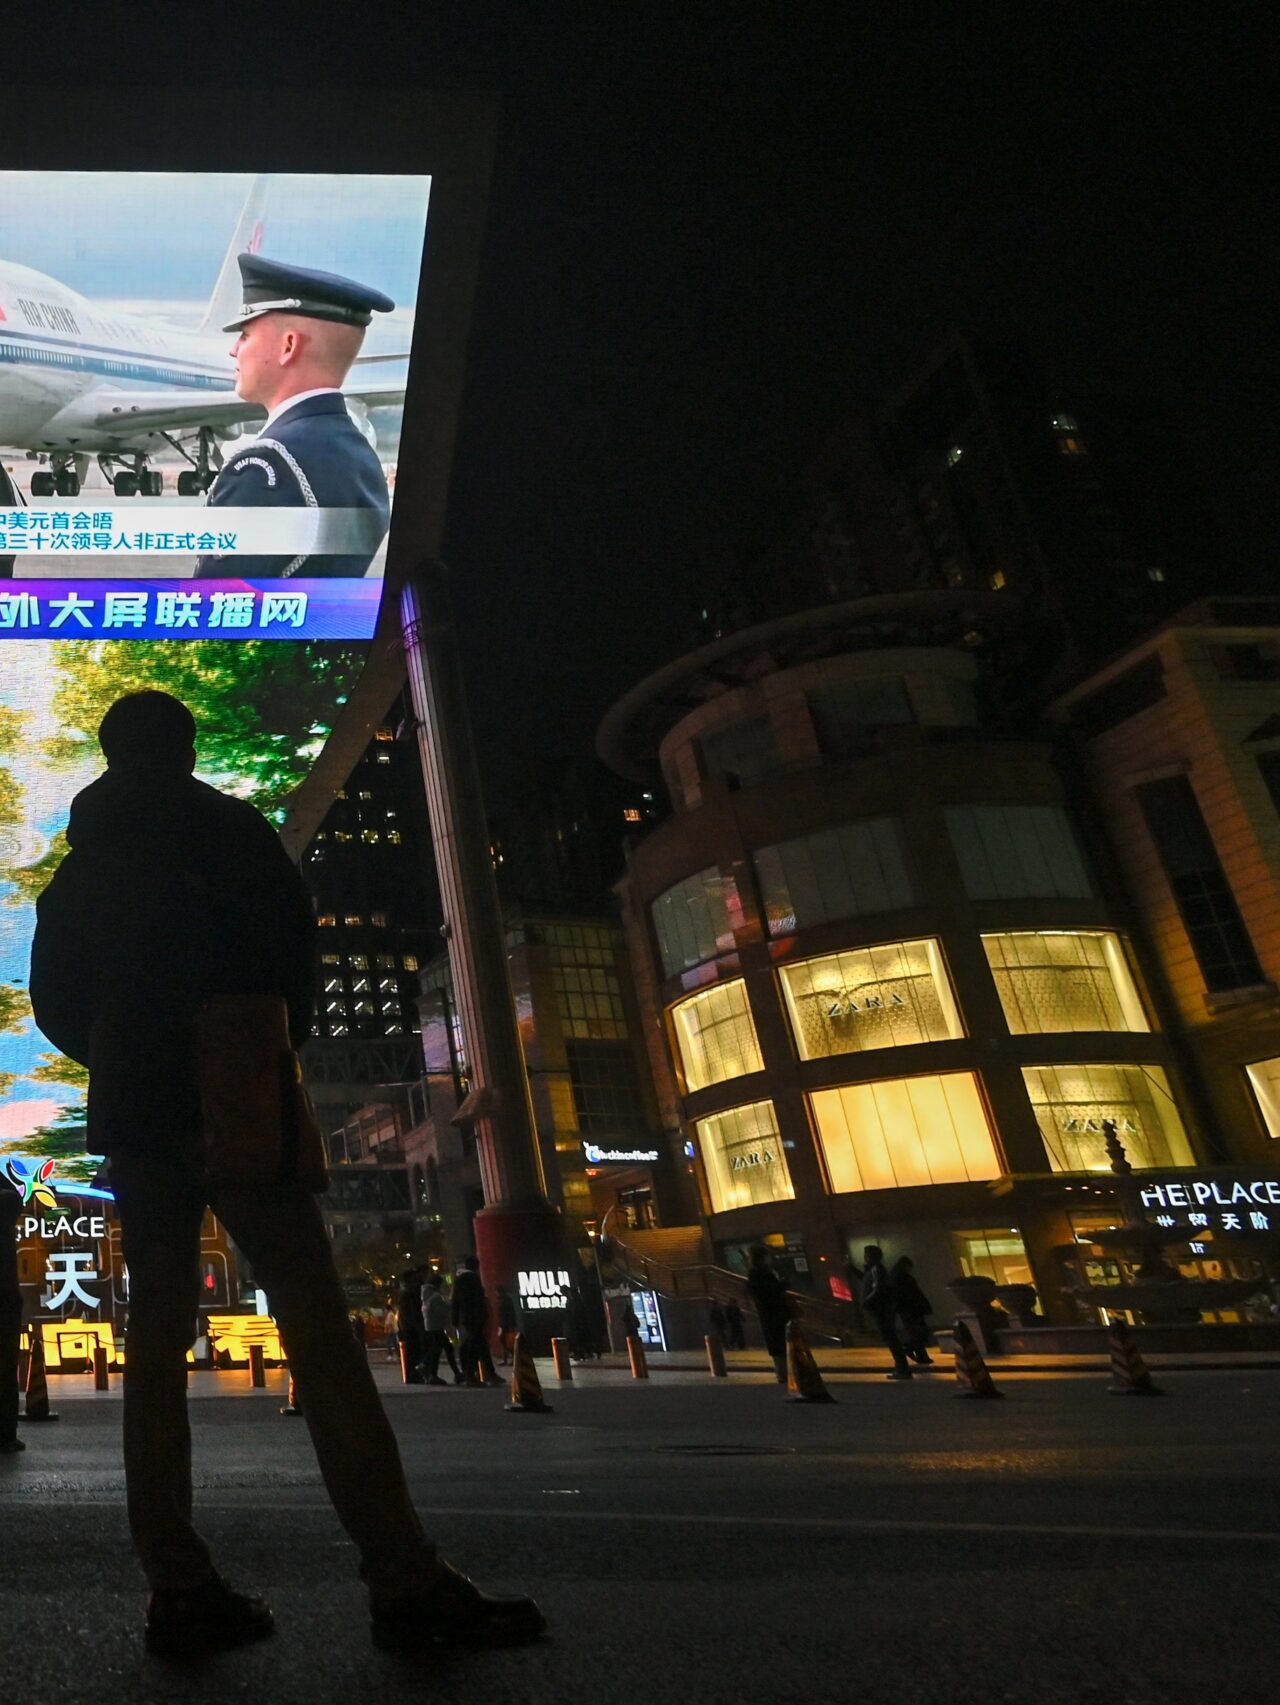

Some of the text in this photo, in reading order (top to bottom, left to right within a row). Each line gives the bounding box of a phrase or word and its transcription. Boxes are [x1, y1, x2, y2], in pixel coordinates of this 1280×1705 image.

[17, 298, 46, 328] AIR
[40, 302, 81, 336] CHINA
[828, 993, 904, 1018] ZARA
[730, 1150, 774, 1170] ZARA
[1192, 1181, 1280, 1206] PLACE
[25, 1216, 105, 1238] PLACE
[45, 1252, 101, 1311] 天
